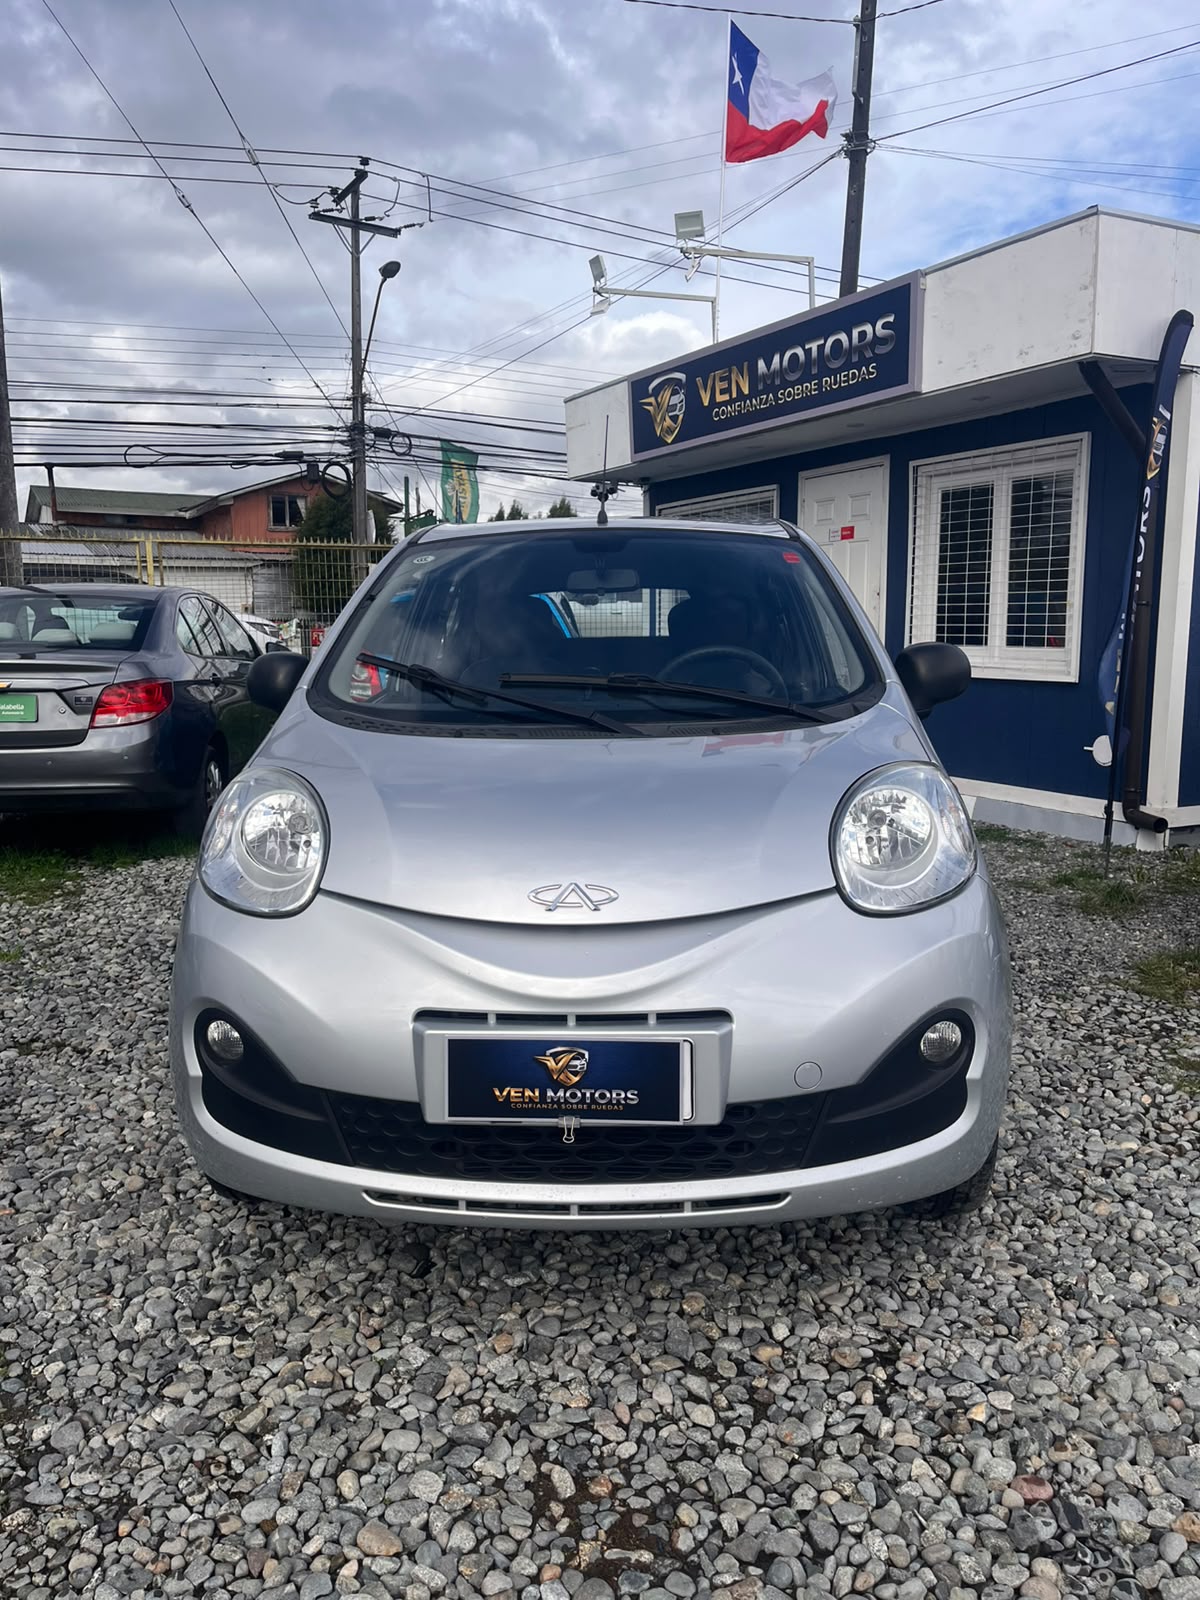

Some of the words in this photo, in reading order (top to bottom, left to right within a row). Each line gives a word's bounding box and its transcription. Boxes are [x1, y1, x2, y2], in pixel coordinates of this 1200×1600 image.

[696, 361, 749, 407] VEN
[757, 313, 895, 390] MOTORS
[712, 392, 775, 421] CONFIANZA
[778, 381, 818, 403] SOBRE
[822, 363, 877, 392] RUEDAS
[493, 1086, 539, 1102] VEN
[546, 1088, 639, 1104] MOTORS
